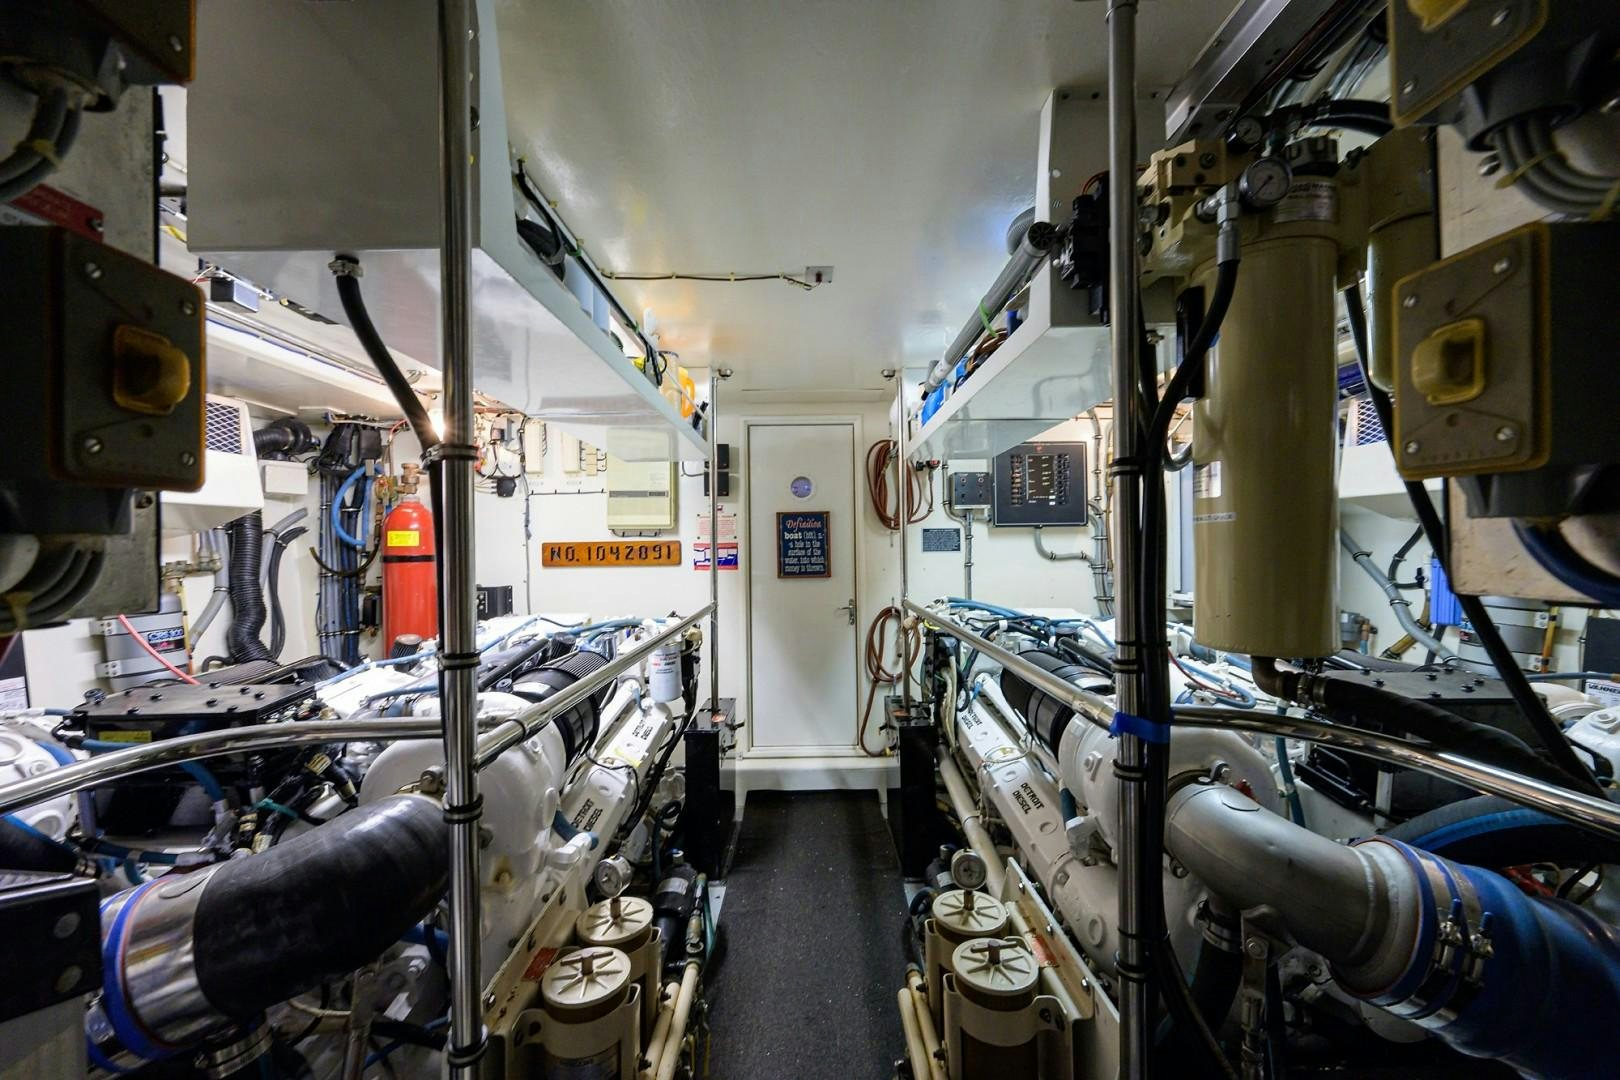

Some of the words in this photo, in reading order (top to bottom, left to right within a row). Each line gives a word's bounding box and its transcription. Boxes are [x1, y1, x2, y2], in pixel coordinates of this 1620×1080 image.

[786, 516, 822, 532] Definition
[784, 531, 802, 539] boat
[550, 546, 580, 562] NO.
[587, 544, 672, 561] 1042891
[811, 556, 825, 564] which
[785, 565, 800, 573] money
[1012, 790, 1031, 814] DIESEL
[1020, 782, 1045, 809] DETROIT
[570, 798, 594, 829] DETROIT
[583, 808, 603, 832] DIESEL
